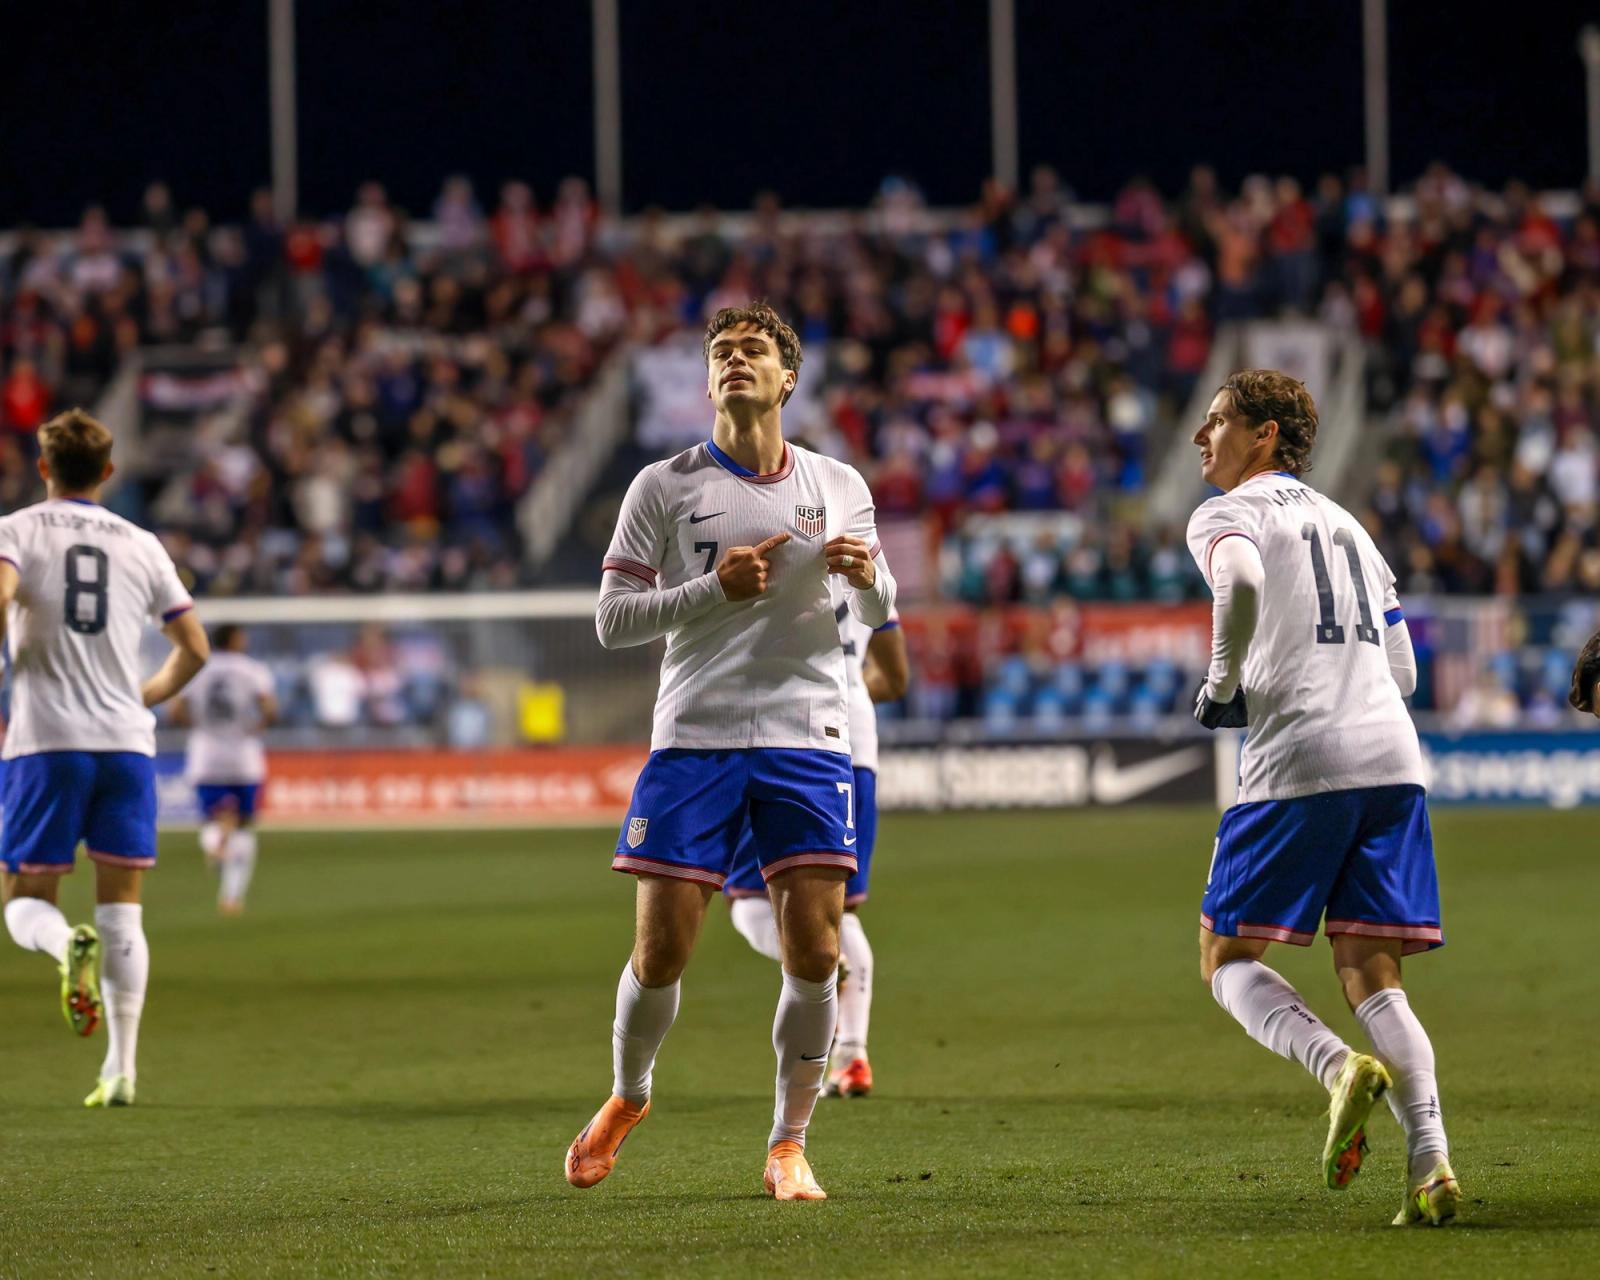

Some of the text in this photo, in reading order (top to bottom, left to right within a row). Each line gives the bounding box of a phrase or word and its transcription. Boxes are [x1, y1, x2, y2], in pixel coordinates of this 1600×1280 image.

[798, 507, 824, 520] USA
[694, 541, 718, 575] 7
[65, 544, 109, 636] 8
[1301, 522, 1380, 646] 11
[630, 818, 647, 831] USA
[836, 782, 854, 829] 7
